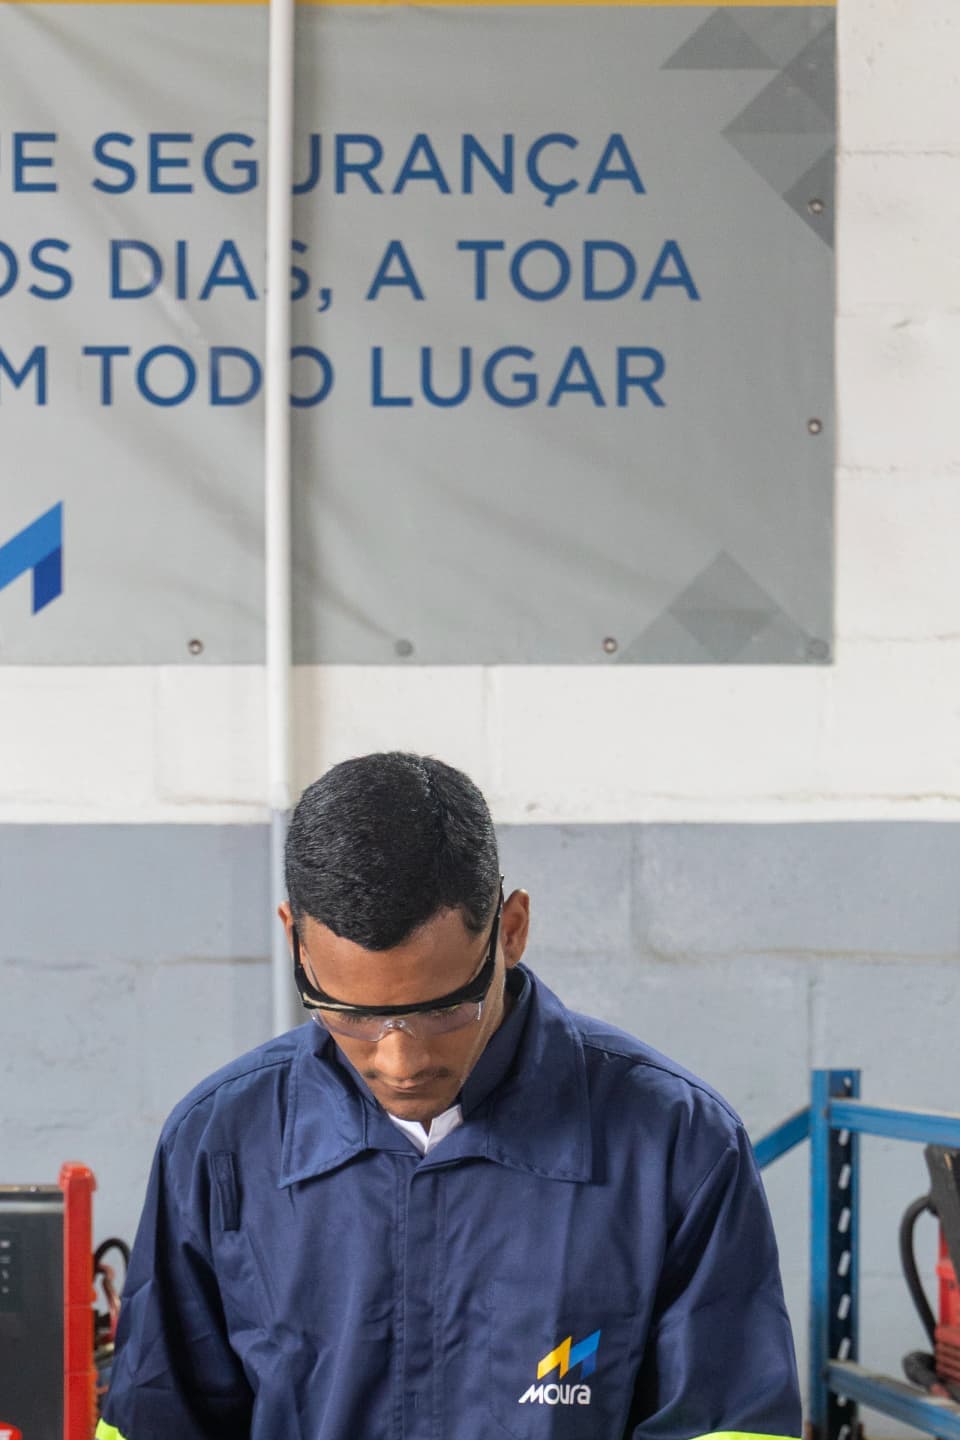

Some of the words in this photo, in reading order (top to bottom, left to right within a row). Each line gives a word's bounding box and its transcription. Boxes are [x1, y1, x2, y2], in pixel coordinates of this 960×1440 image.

[94, 132, 645, 207] SEGURANÇA
[367, 240, 424, 300] A
[457, 240, 700, 301] TODA
[83, 345, 333, 408] TODO
[372, 346, 666, 408] LUGAR
